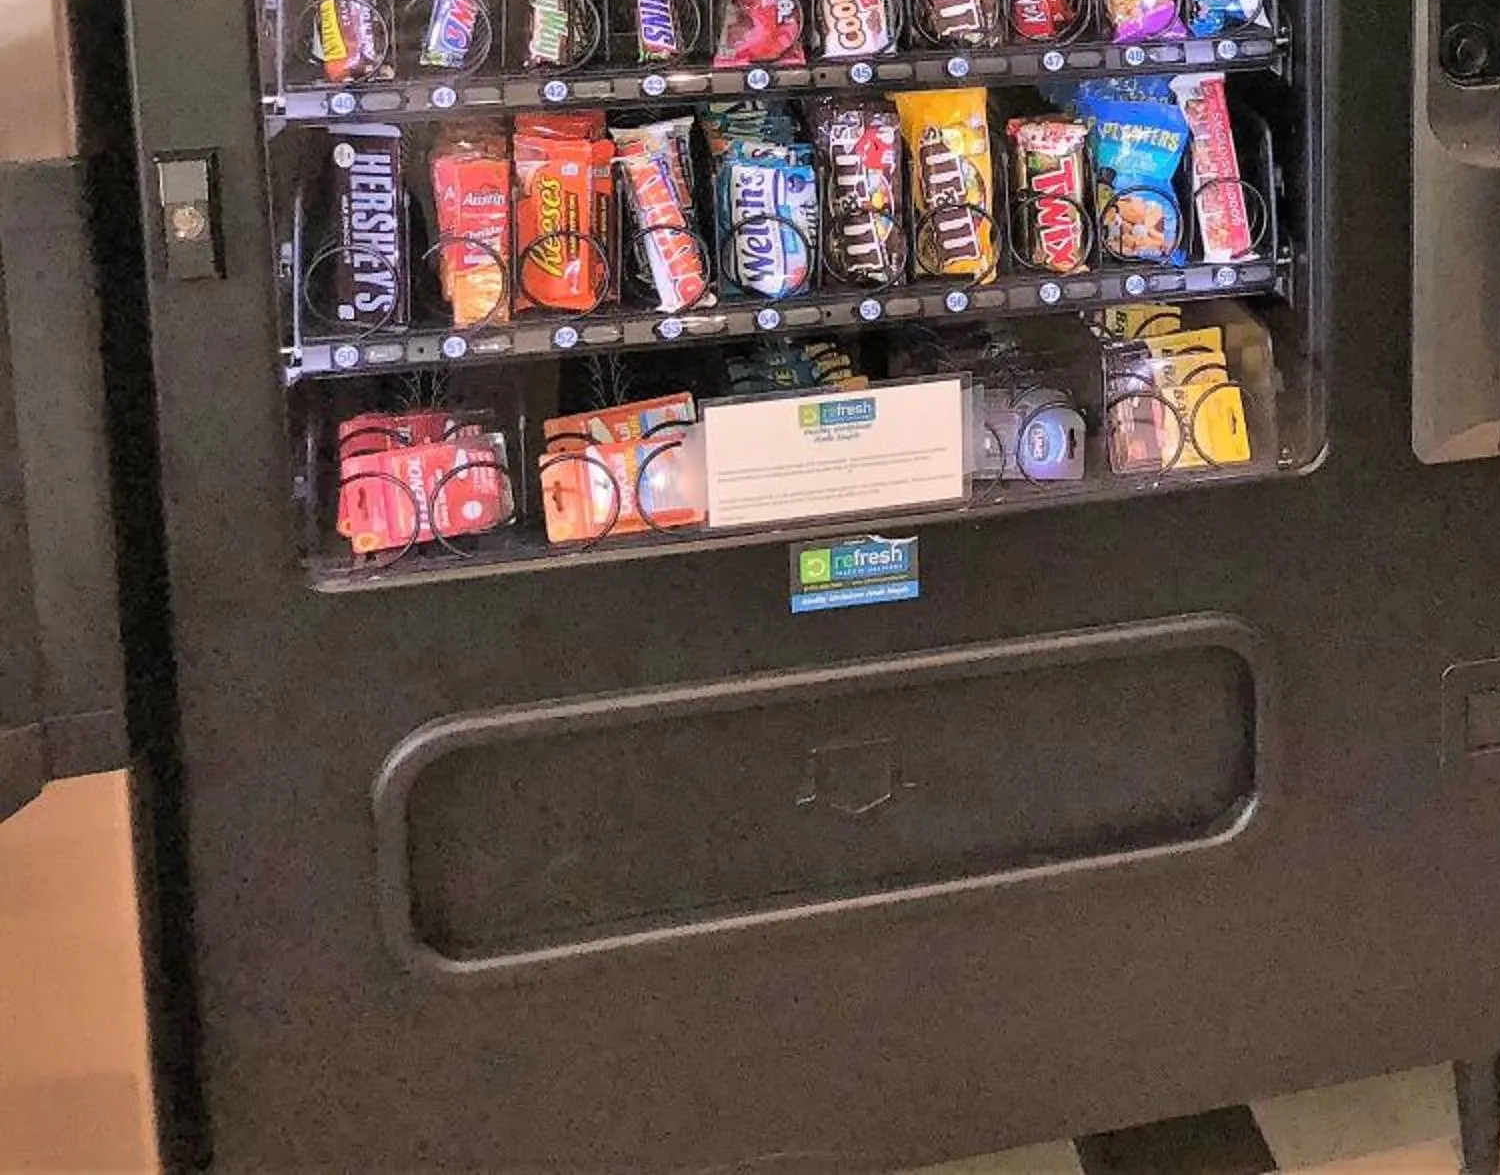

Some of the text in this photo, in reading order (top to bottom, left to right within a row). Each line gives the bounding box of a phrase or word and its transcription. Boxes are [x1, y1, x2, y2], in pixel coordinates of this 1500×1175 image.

[1046, 55, 1060, 66] 47
[1128, 51, 1142, 61] 48
[854, 67, 870, 79] 45
[950, 61, 966, 73] 46
[750, 73, 766, 85] 44
[436, 92, 452, 103] 41
[546, 85, 564, 97] 42
[333, 97, 353, 110] 40
[462, 191, 506, 207] Austin
[1031, 155, 1077, 266] TWIX
[351, 153, 396, 313] HERSHEY'S
[528, 175, 565, 278] Reese's
[1218, 269, 1235, 283] 59
[950, 296, 965, 308] 56
[862, 304, 878, 316] 55
[760, 313, 776, 325] 54
[558, 331, 574, 344] 52
[446, 341, 462, 354] 51
[337, 349, 355, 364] 50
[823, 401, 872, 419] refresh
[834, 544, 903, 569] refresh
